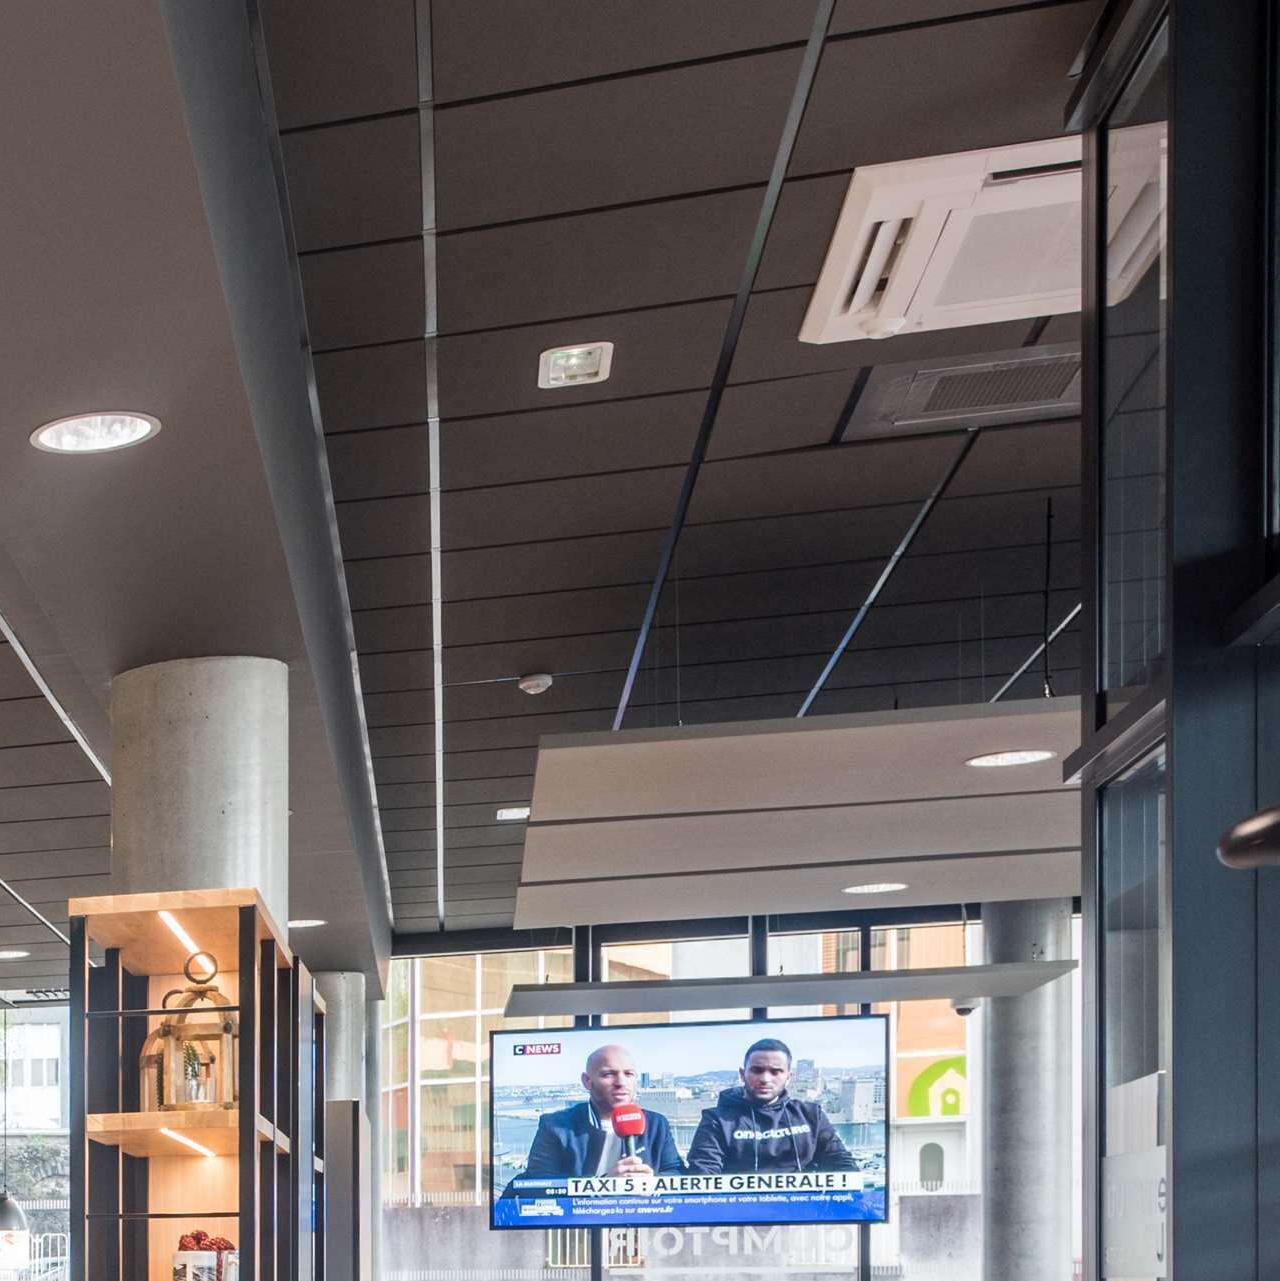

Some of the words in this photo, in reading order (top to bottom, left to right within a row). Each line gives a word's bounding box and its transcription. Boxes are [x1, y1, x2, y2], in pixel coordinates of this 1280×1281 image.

[525, 1044, 559, 1054] NEWS
[572, 1179, 617, 1193] TAXI
[624, 1179, 634, 1192] 5
[655, 1177, 723, 1191] ALERTE
[729, 1174, 834, 1190] GENERALE
